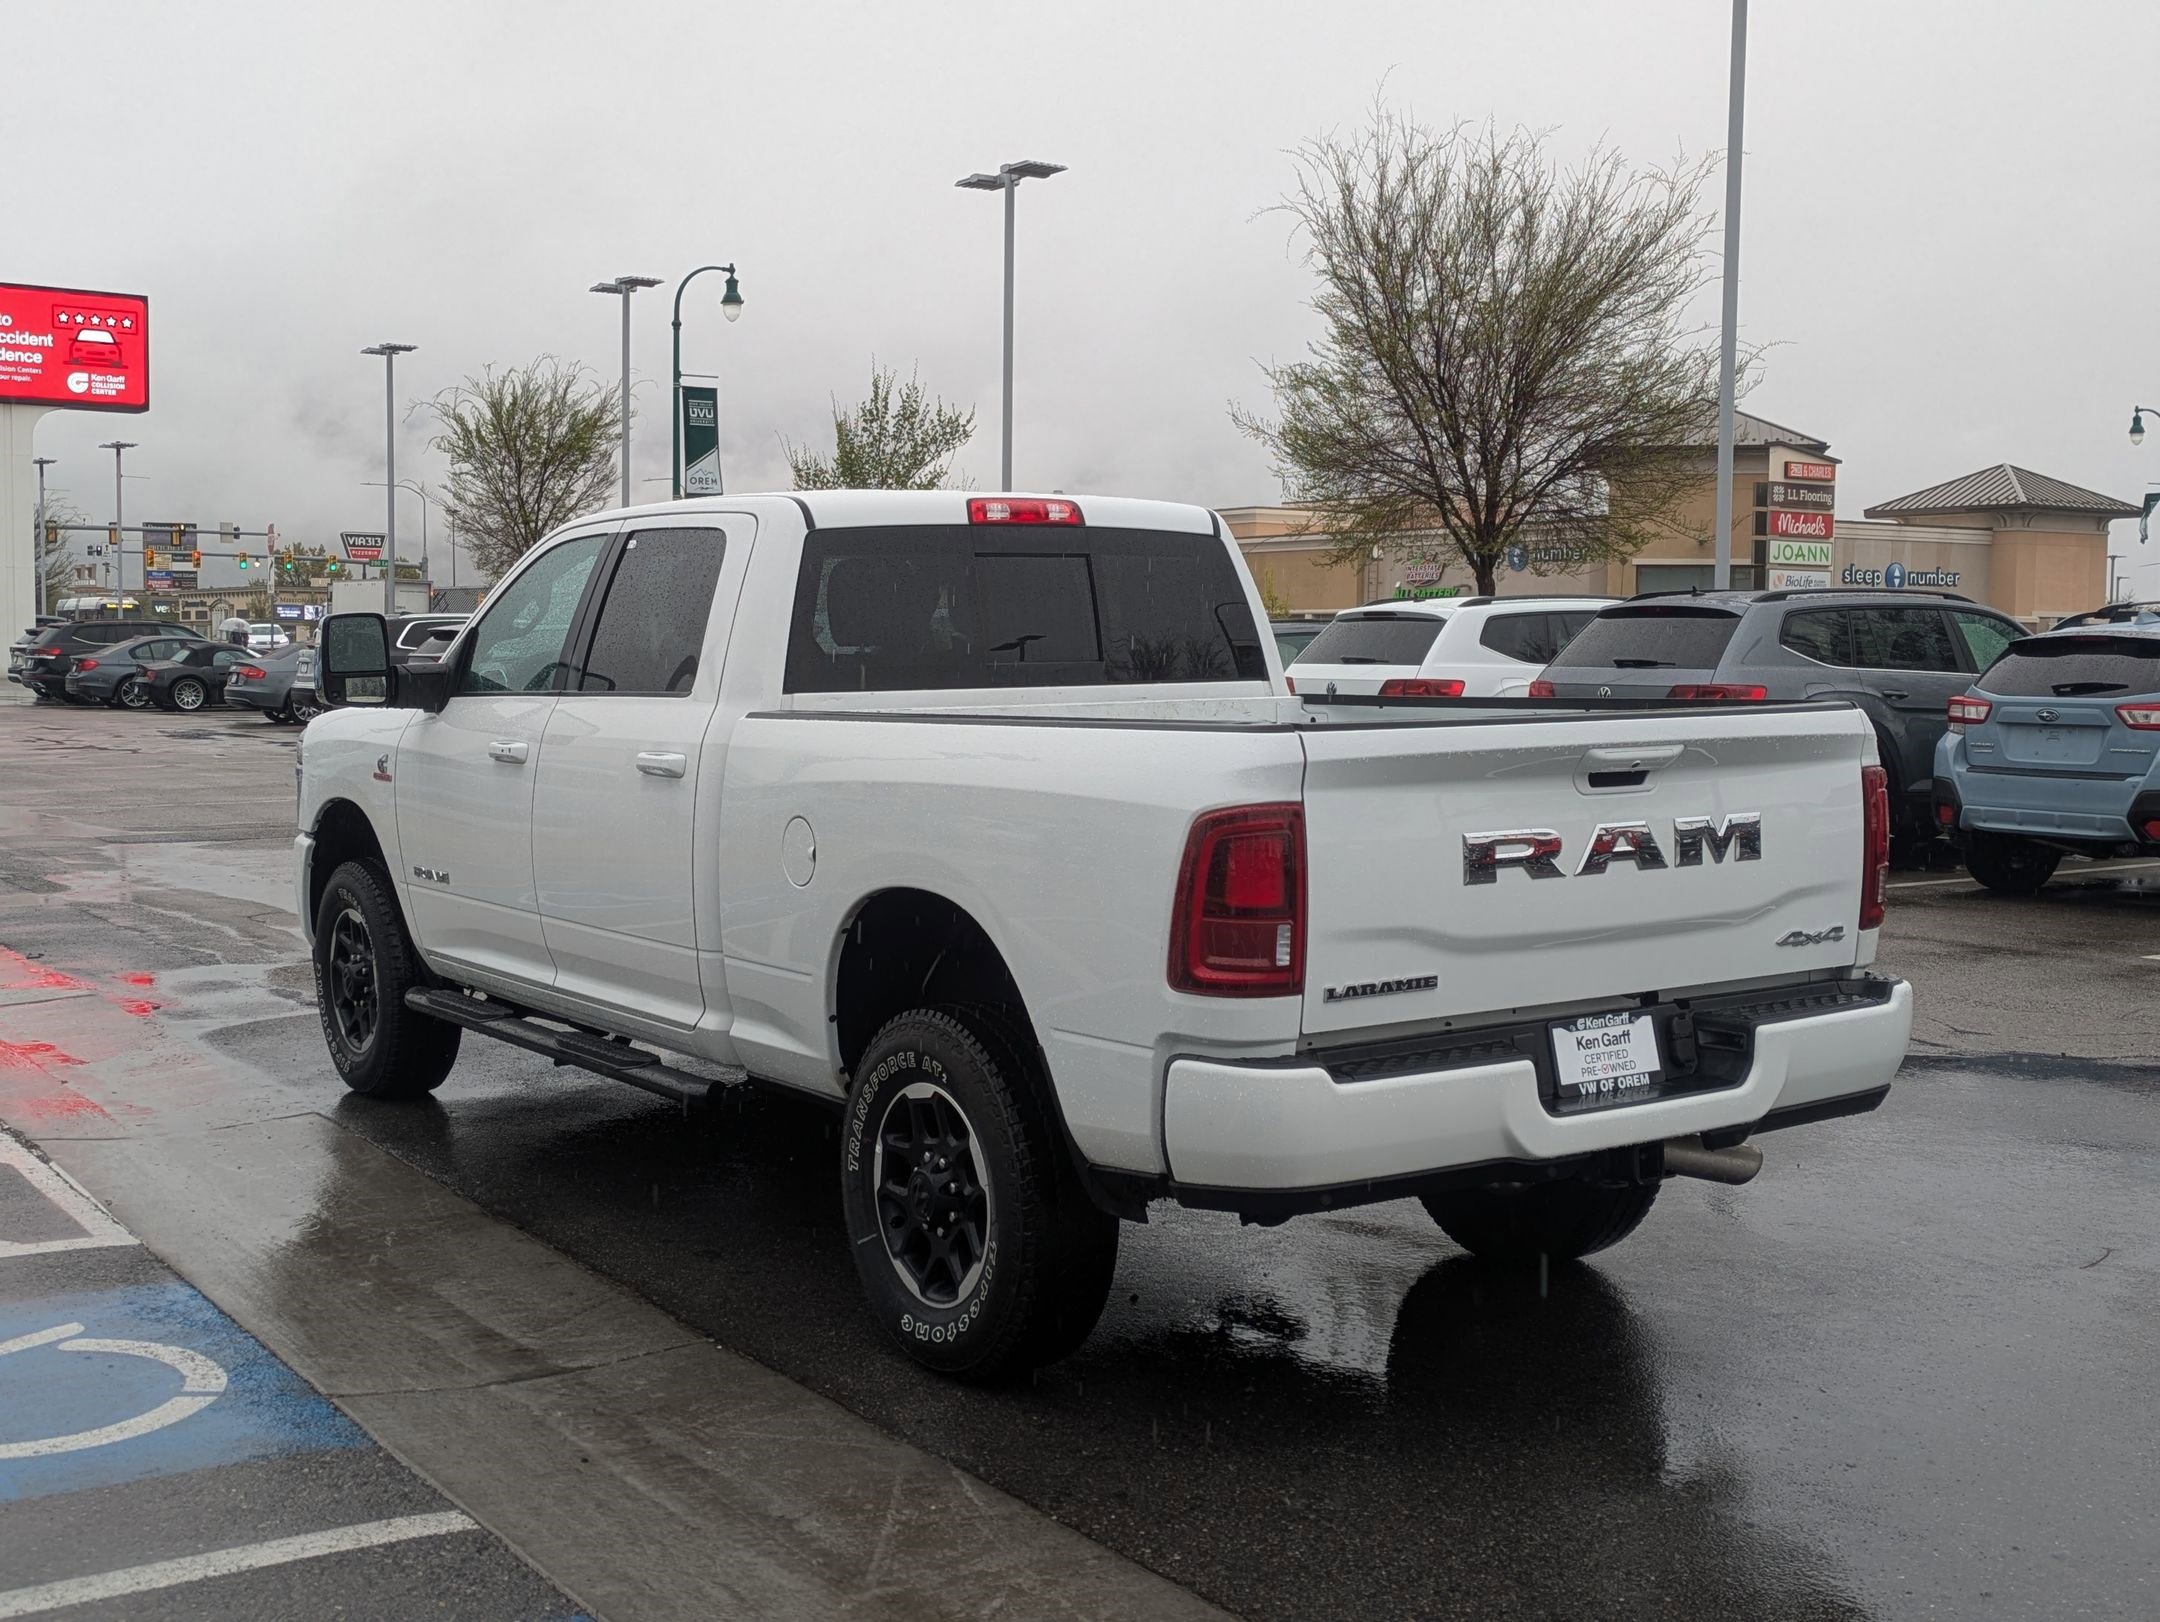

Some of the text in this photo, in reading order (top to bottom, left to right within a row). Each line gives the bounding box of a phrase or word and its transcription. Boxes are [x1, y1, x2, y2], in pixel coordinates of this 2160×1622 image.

[17, 366, 42, 374] Centers
[106, 375, 125, 383] Garff
[91, 382, 125, 390] COLLISION
[690, 408, 713, 418] UVU
[689, 476, 717, 485] OREM
[1788, 489, 1832, 506] LL Flooring
[1778, 513, 1826, 536] Michaels
[1772, 543, 1830, 562] JOANN
[1785, 575, 1813, 588] BioLife
[1843, 565, 1882, 587] sleep
[1910, 567, 1960, 585] number
[1462, 812, 1762, 887] RAM
[1776, 926, 1846, 947] 4x4
[1323, 975, 1439, 1003] LARAMIE
[1585, 1011, 1630, 1029] Ken Garff
[1576, 1029, 1631, 1051] Ken Garff
[1584, 1049, 1629, 1065] CERTIFIED
[1579, 1073, 1650, 1095] VW OF OREM
[847, 1051, 917, 1172] TRANSFORCE
[901, 1240, 998, 1343] Firestone
